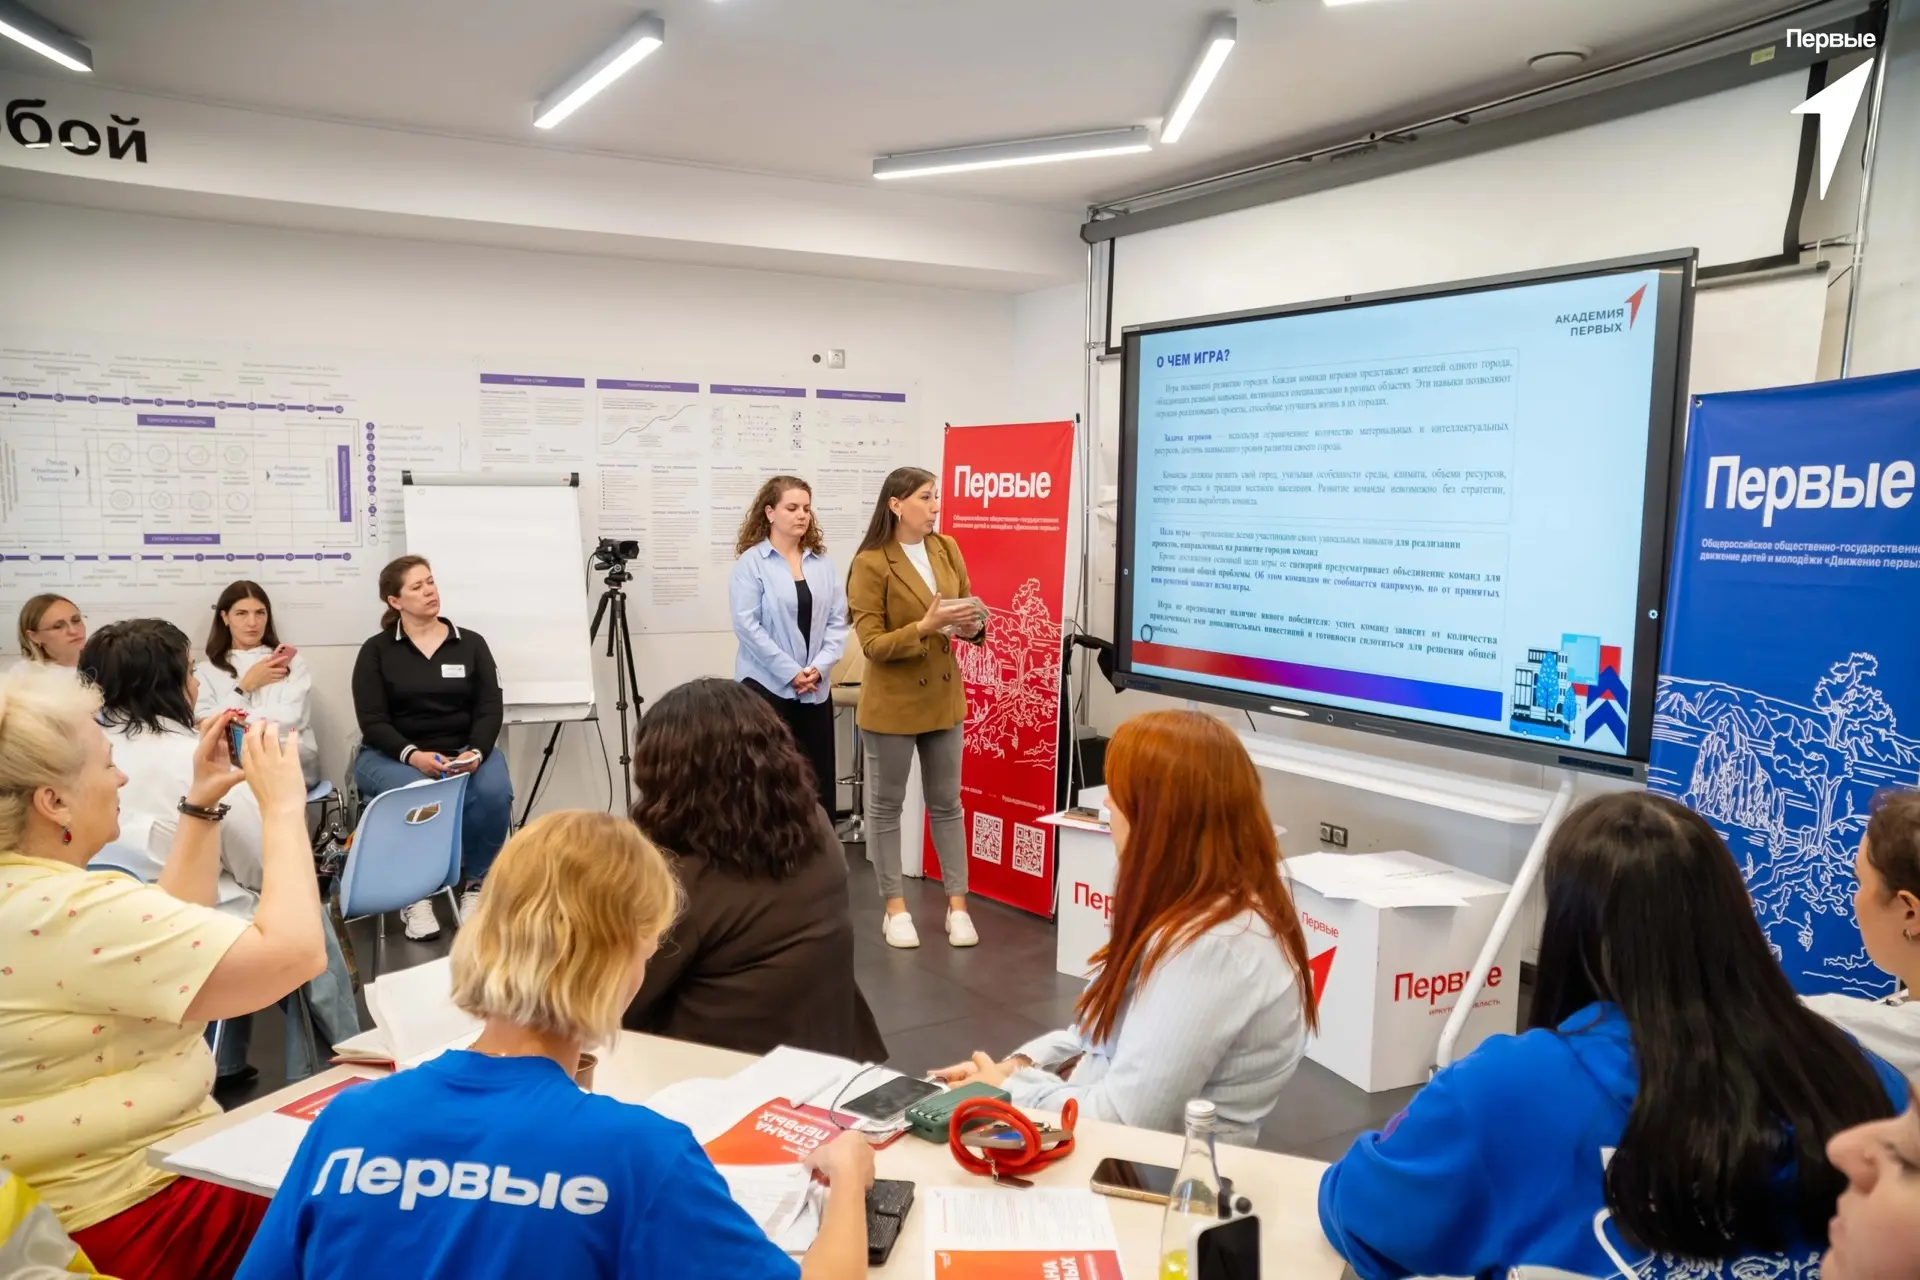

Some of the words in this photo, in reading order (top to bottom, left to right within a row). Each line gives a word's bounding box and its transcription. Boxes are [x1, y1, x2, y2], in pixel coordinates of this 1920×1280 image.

[0, 99, 148, 164] бой
[1555, 308, 1624, 324] АКАДЕМИЯ
[1570, 323, 1622, 337] ПЕРВЫХ
[1157, 356, 1164, 368] О
[1168, 353, 1190, 367] ЧЕМ
[1194, 349, 1230, 364] ИГРА?
[1272, 375, 1297, 385] Каждая
[1329, 371, 1357, 382] игроков
[1360, 366, 1408, 379] представляет
[1412, 362, 1446, 374] жителей
[1449, 361, 1478, 372] одного
[1481, 358, 1513, 371] города,
[1350, 383, 1376, 395] разных
[1415, 379, 1431, 389] Эти
[1433, 377, 1463, 388] навыки
[1465, 375, 1511, 387] позволяют
[1358, 397, 1388, 409] городах.
[1315, 428, 1353, 438] количество
[1360, 426, 1412, 438] материальных
[1431, 422, 1509, 435] интеллектуальных
[1316, 469, 1361, 479] особенности
[1365, 471, 1389, 481] среды,
[1393, 470, 1428, 480] климата,
[1432, 468, 1461, 479] объема
[1465, 470, 1507, 481] ресурсов,
[953, 465, 1052, 509] Первые
[1318, 483, 1349, 493] Развитие
[1353, 485, 1386, 494] команды
[1390, 485, 1438, 494] невозможно
[1442, 483, 1456, 493] без
[1461, 485, 1506, 496] стратегии,
[1705, 455, 1916, 528] Первые
[1234, 544, 1263, 554] развитие
[1265, 546, 1290, 556] городов
[1292, 547, 1319, 557] команд
[1298, 534, 1316, 543] своих
[1395, 538, 1409, 547] для
[1411, 539, 1461, 550] реализации
[1702, 538, 1773, 550] Общероссийское
[1261, 559, 1277, 568] игры
[1289, 560, 1322, 572] сценарий
[1325, 562, 1390, 576] предусматривает
[1392, 566, 1446, 579] объединение
[1448, 571, 1481, 581] команд
[1484, 574, 1501, 582] для
[1700, 552, 1740, 561] движение
[1741, 553, 1767, 564] детей
[1775, 555, 1823, 566] молодёжи
[1825, 555, 1881, 568] «Движение
[1232, 583, 1252, 593] игры.
[1254, 570, 1265, 580] Об
[1267, 572, 1283, 581] этом
[1285, 574, 1319, 584] командам
[1322, 577, 1331, 585] не
[1333, 576, 1377, 589] сообщается
[1380, 582, 1425, 594] напрямую,
[1428, 585, 1438, 593] но
[1441, 586, 1451, 594] от
[1455, 587, 1500, 598] принятых
[1157, 600, 1172, 610] Игра
[1230, 608, 1257, 619] наличие
[1261, 612, 1284, 622] явного
[1288, 614, 1331, 627] победителя:
[1335, 620, 1356, 630] успех
[1360, 623, 1389, 633] команд
[1394, 625, 1426, 637] зависит
[1431, 630, 1441, 639] от
[1446, 632, 1498, 645] количества
[1209, 620, 1261, 632] дополнительных
[1264, 625, 1305, 637] инвестиций
[1316, 632, 1356, 643] готовности
[1359, 637, 1404, 649] сплотиться
[1408, 642, 1423, 652] для
[1426, 644, 1464, 656] решения
[1468, 648, 1497, 660] общей
[1074, 881, 1116, 920] Пер
[1302, 911, 1339, 939] Первые
[1394, 966, 1502, 1005] Перве
[755, 1120, 820, 1150] СТРАНА
[758, 1110, 831, 1141] ПЕРВЫХ
[311, 1147, 609, 1216] Первые
